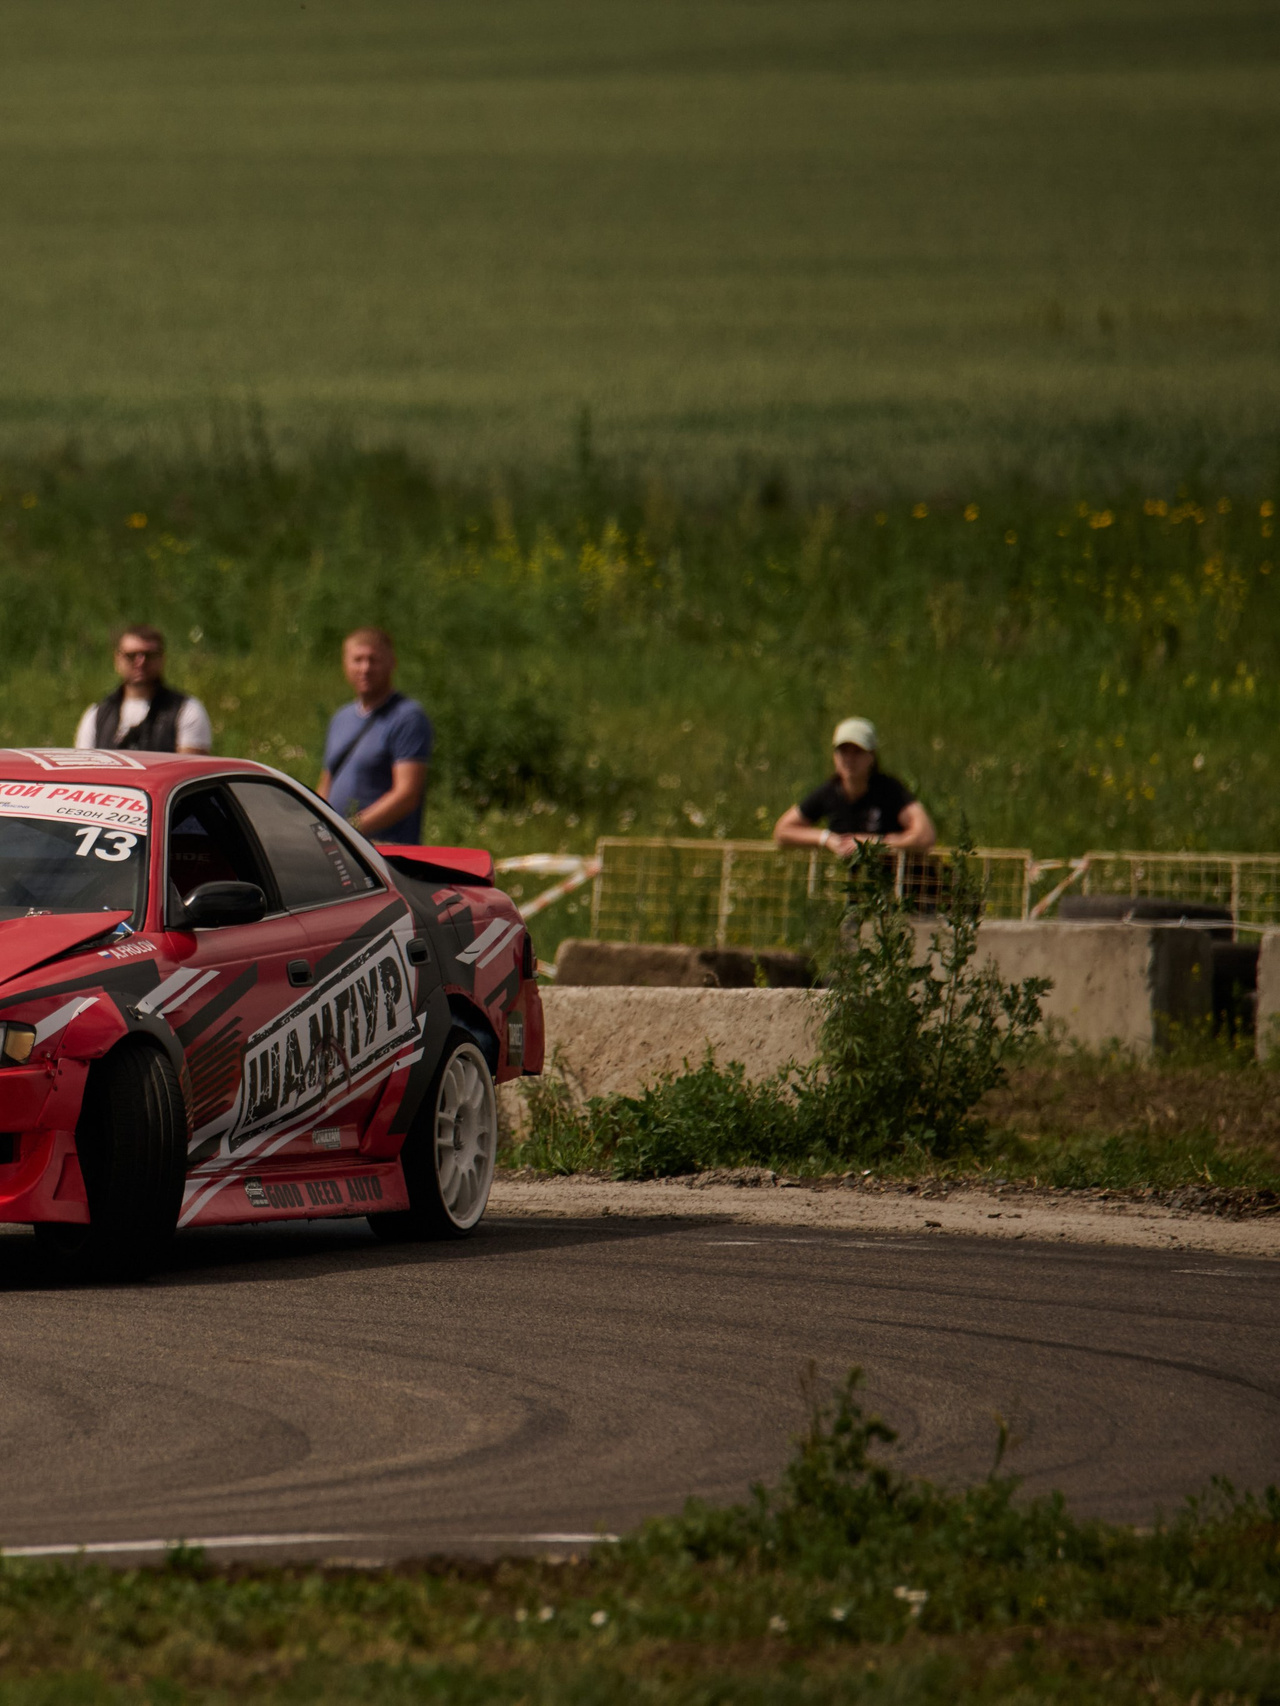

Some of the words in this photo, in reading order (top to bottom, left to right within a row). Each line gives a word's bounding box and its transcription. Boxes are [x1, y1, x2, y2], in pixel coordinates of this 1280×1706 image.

[56, 807, 104, 819] СЕЗОН
[75, 826, 137, 862] 13
[241, 955, 403, 1129] ШАМПУР
[265, 1183, 305, 1209] GOOD
[304, 1180, 344, 1206] DEED
[345, 1175, 383, 1202] AUTO
